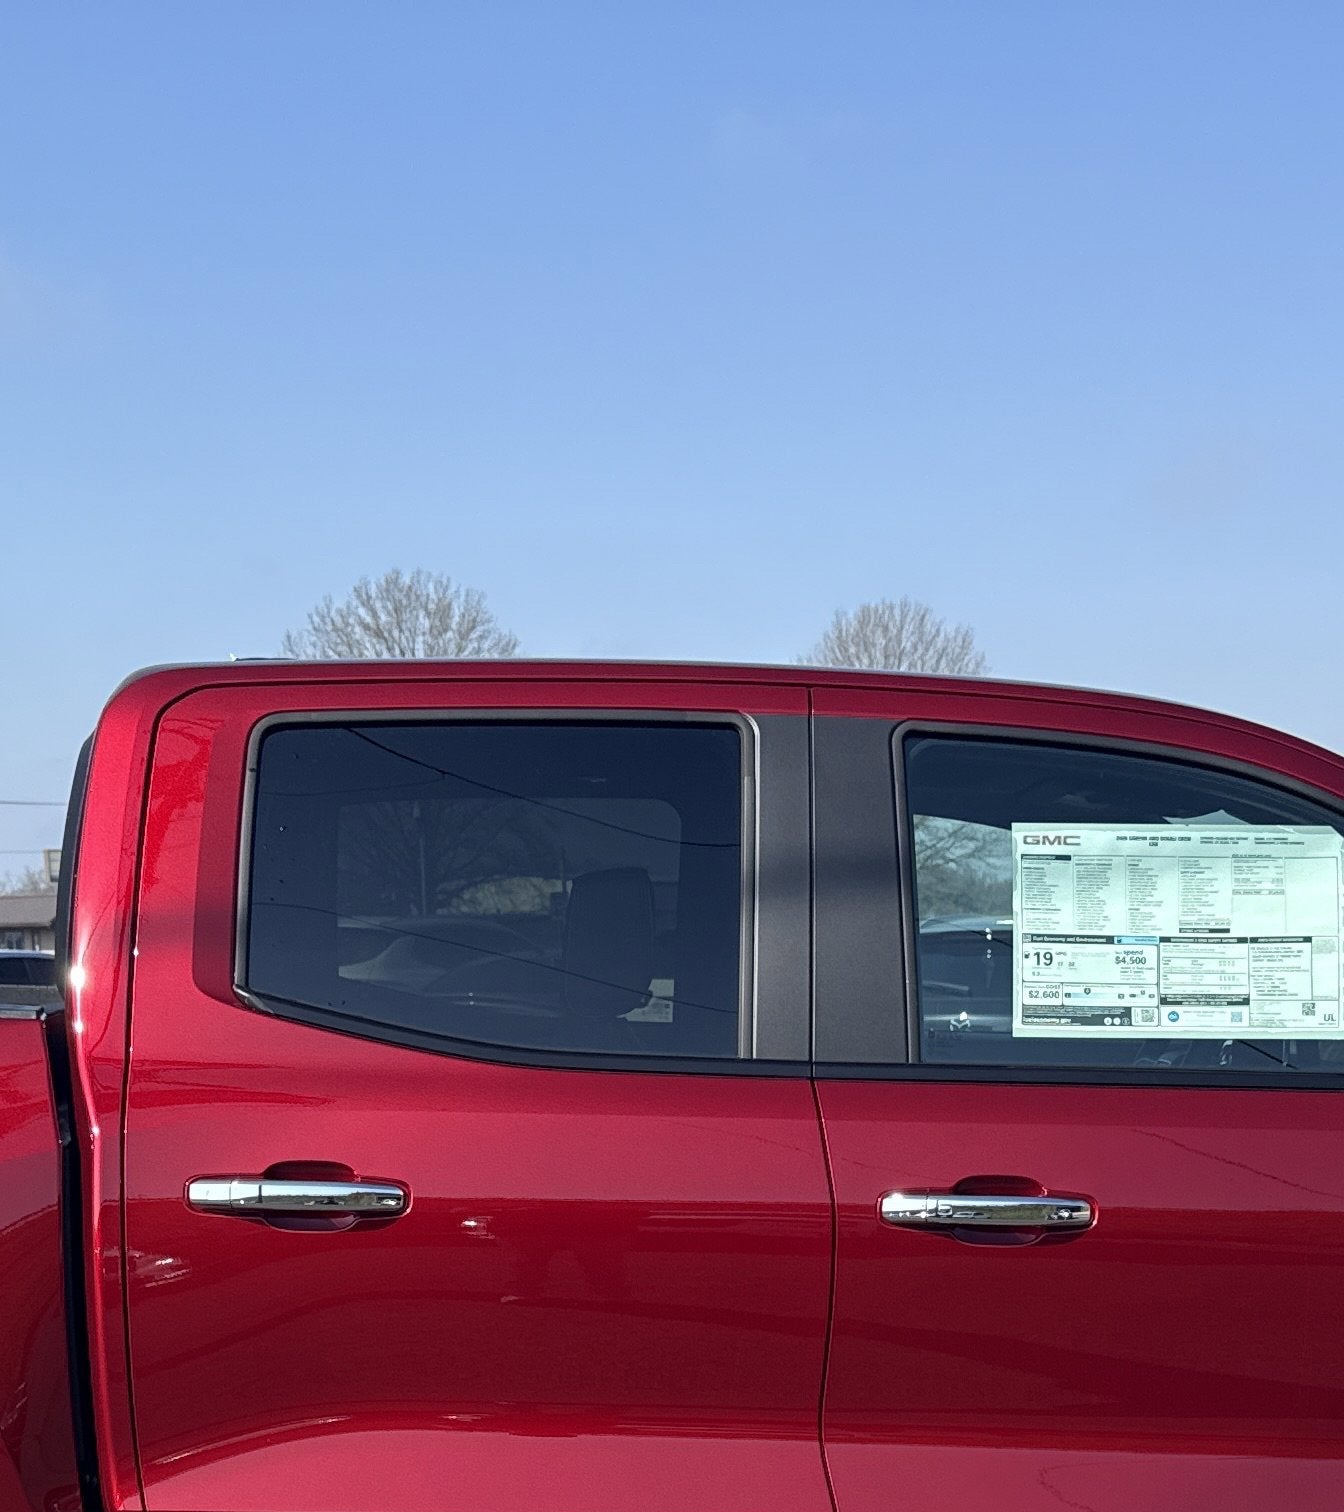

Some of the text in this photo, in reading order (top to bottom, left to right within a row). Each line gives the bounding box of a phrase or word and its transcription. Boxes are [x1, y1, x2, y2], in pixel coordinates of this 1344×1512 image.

[1023, 835, 1081, 846] GMC
[1033, 951, 1053, 966] 19
[1115, 956, 1147, 965] $4,500
[1028, 990, 1060, 999] $2,600
